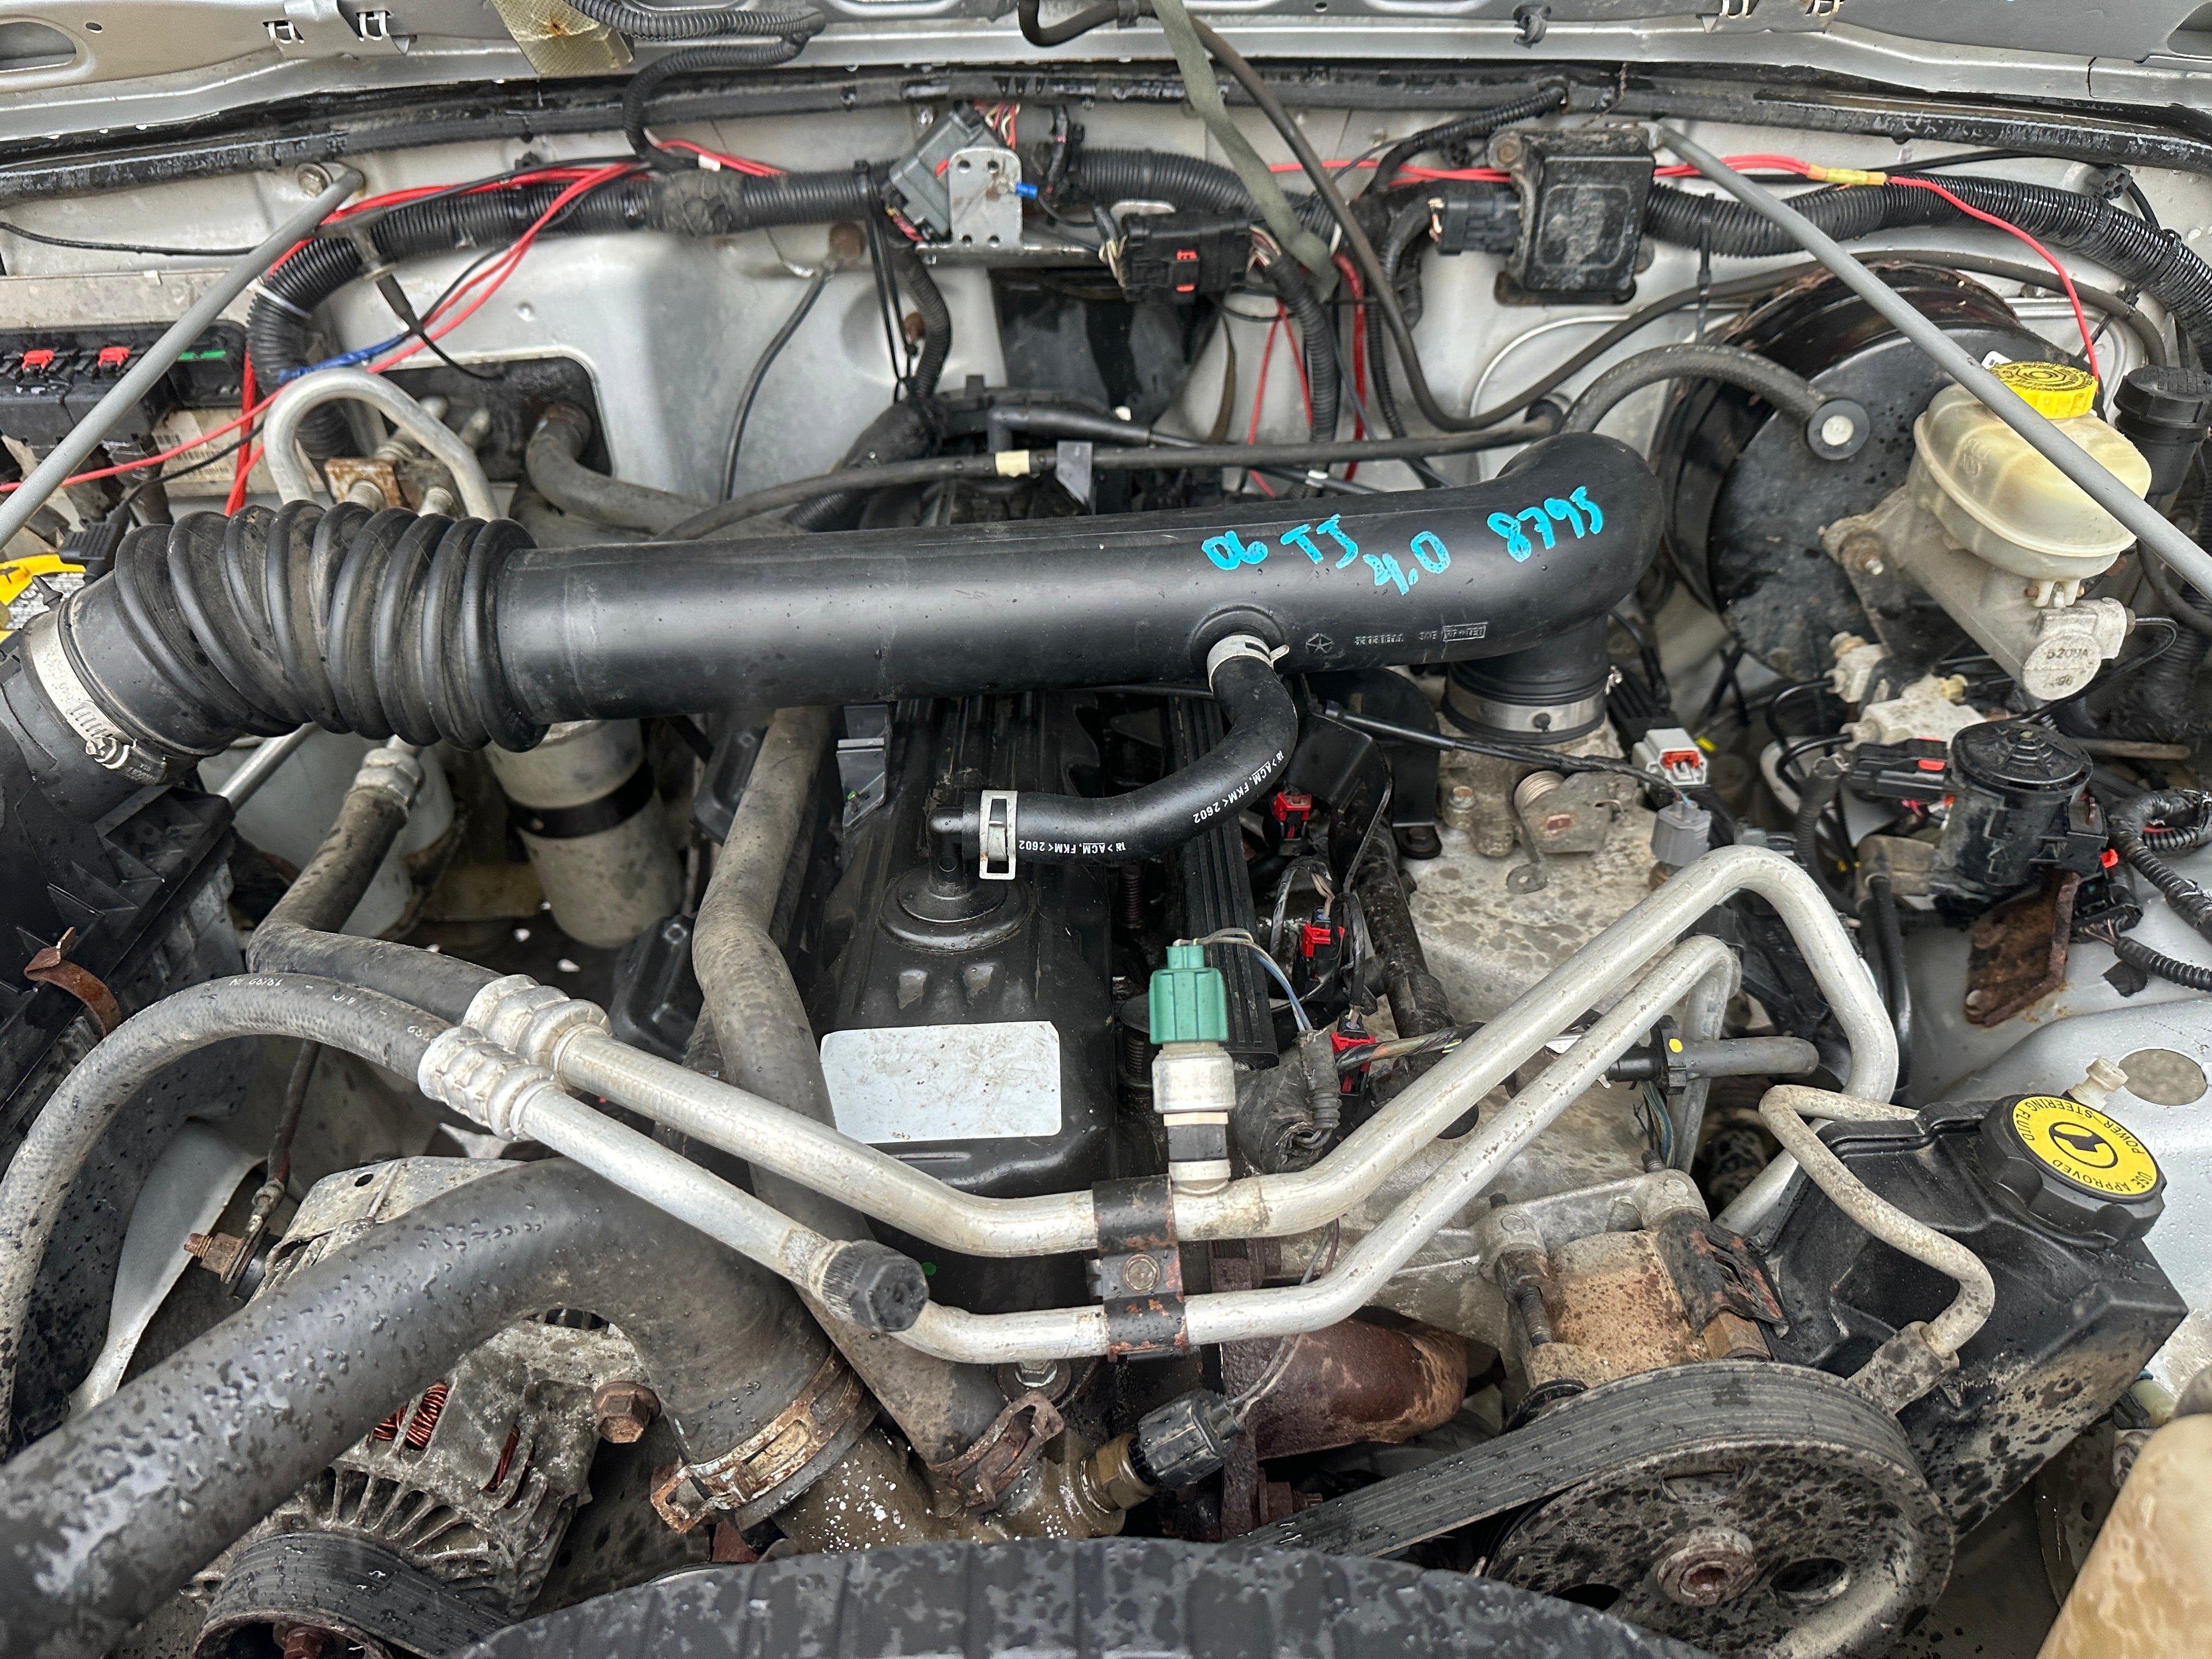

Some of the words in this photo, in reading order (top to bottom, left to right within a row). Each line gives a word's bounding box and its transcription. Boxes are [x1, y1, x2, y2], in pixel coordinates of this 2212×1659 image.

[1202, 531, 1268, 570] 06
[1280, 513, 1358, 569] TJ
[1362, 530, 1450, 596] 4.0
[1487, 485, 1603, 562] 8795
[1192, 801, 1221, 824] 2602
[1018, 840, 1045, 851] 2602
[2025, 1099, 2093, 1118] STEERING
[2016, 1108, 2035, 1141] FLUID
[2103, 1120, 2145, 1154] POWER
[2052, 1159, 2131, 1192] APPROVED
[2131, 1171, 2153, 1189] USE
